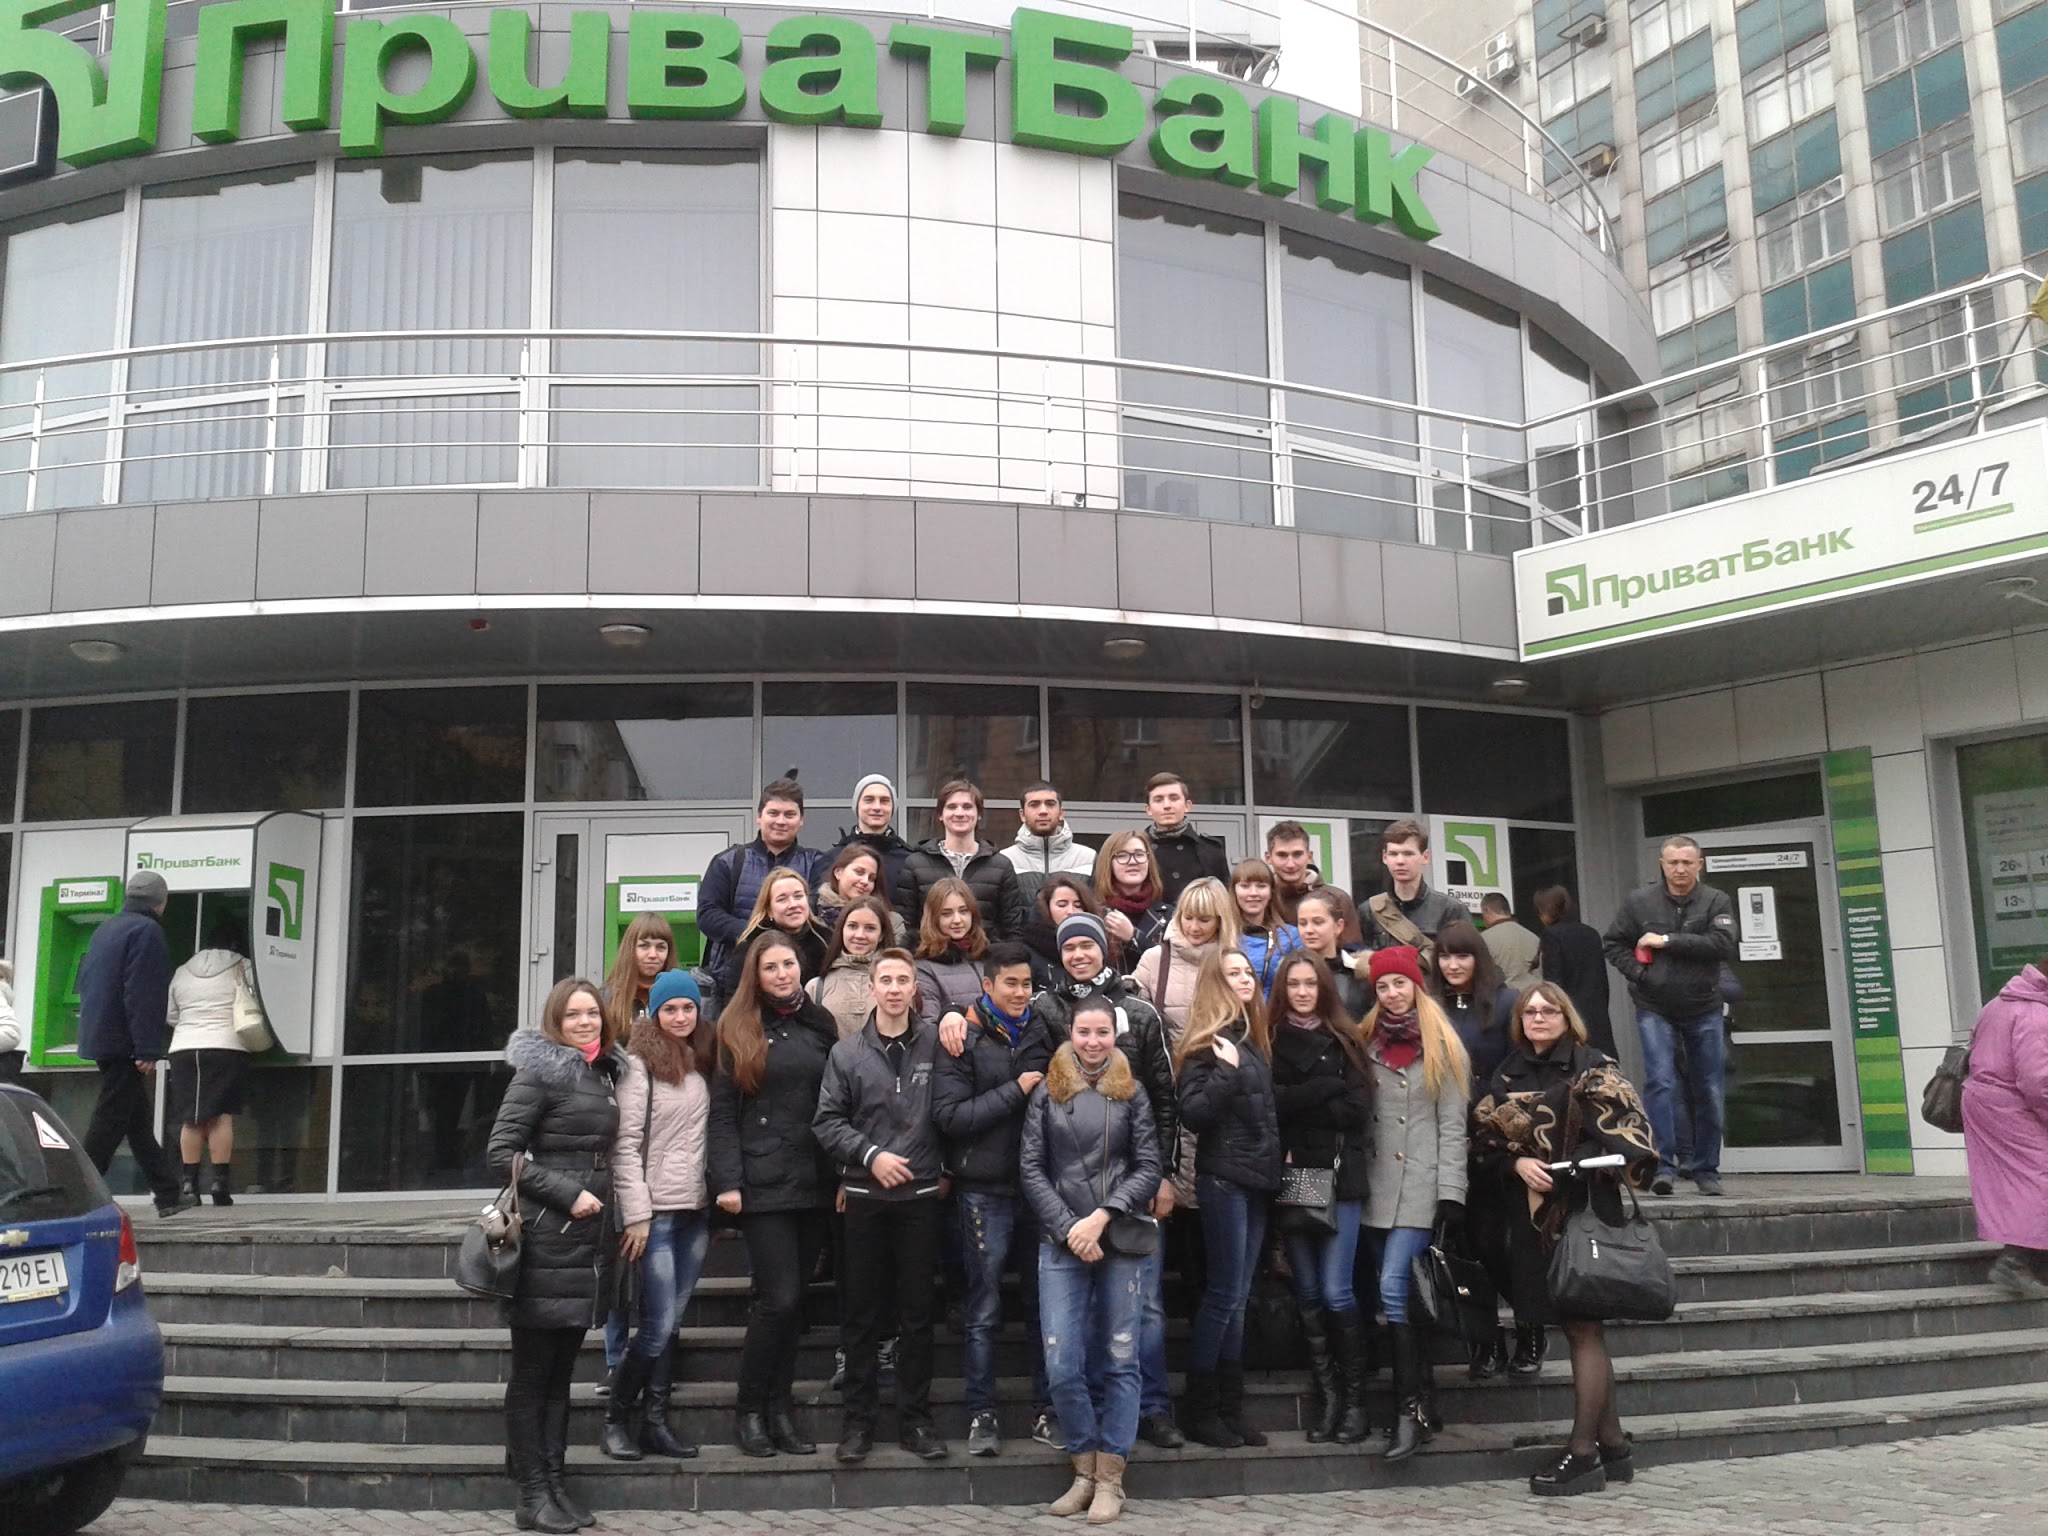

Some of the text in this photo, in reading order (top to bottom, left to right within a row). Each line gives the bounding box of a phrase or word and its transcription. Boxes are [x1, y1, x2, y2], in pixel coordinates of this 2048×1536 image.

[192, 0, 1441, 242] ПриватБанк
[1912, 461, 2010, 513] 24/7
[1592, 527, 1854, 608] ПриватБанк
[154, 855, 241, 870] ПриватБанк
[1776, 853, 1800, 864] 24/7
[637, 895, 690, 903] ПриватБанк
[1447, 888, 1487, 900] Банком
